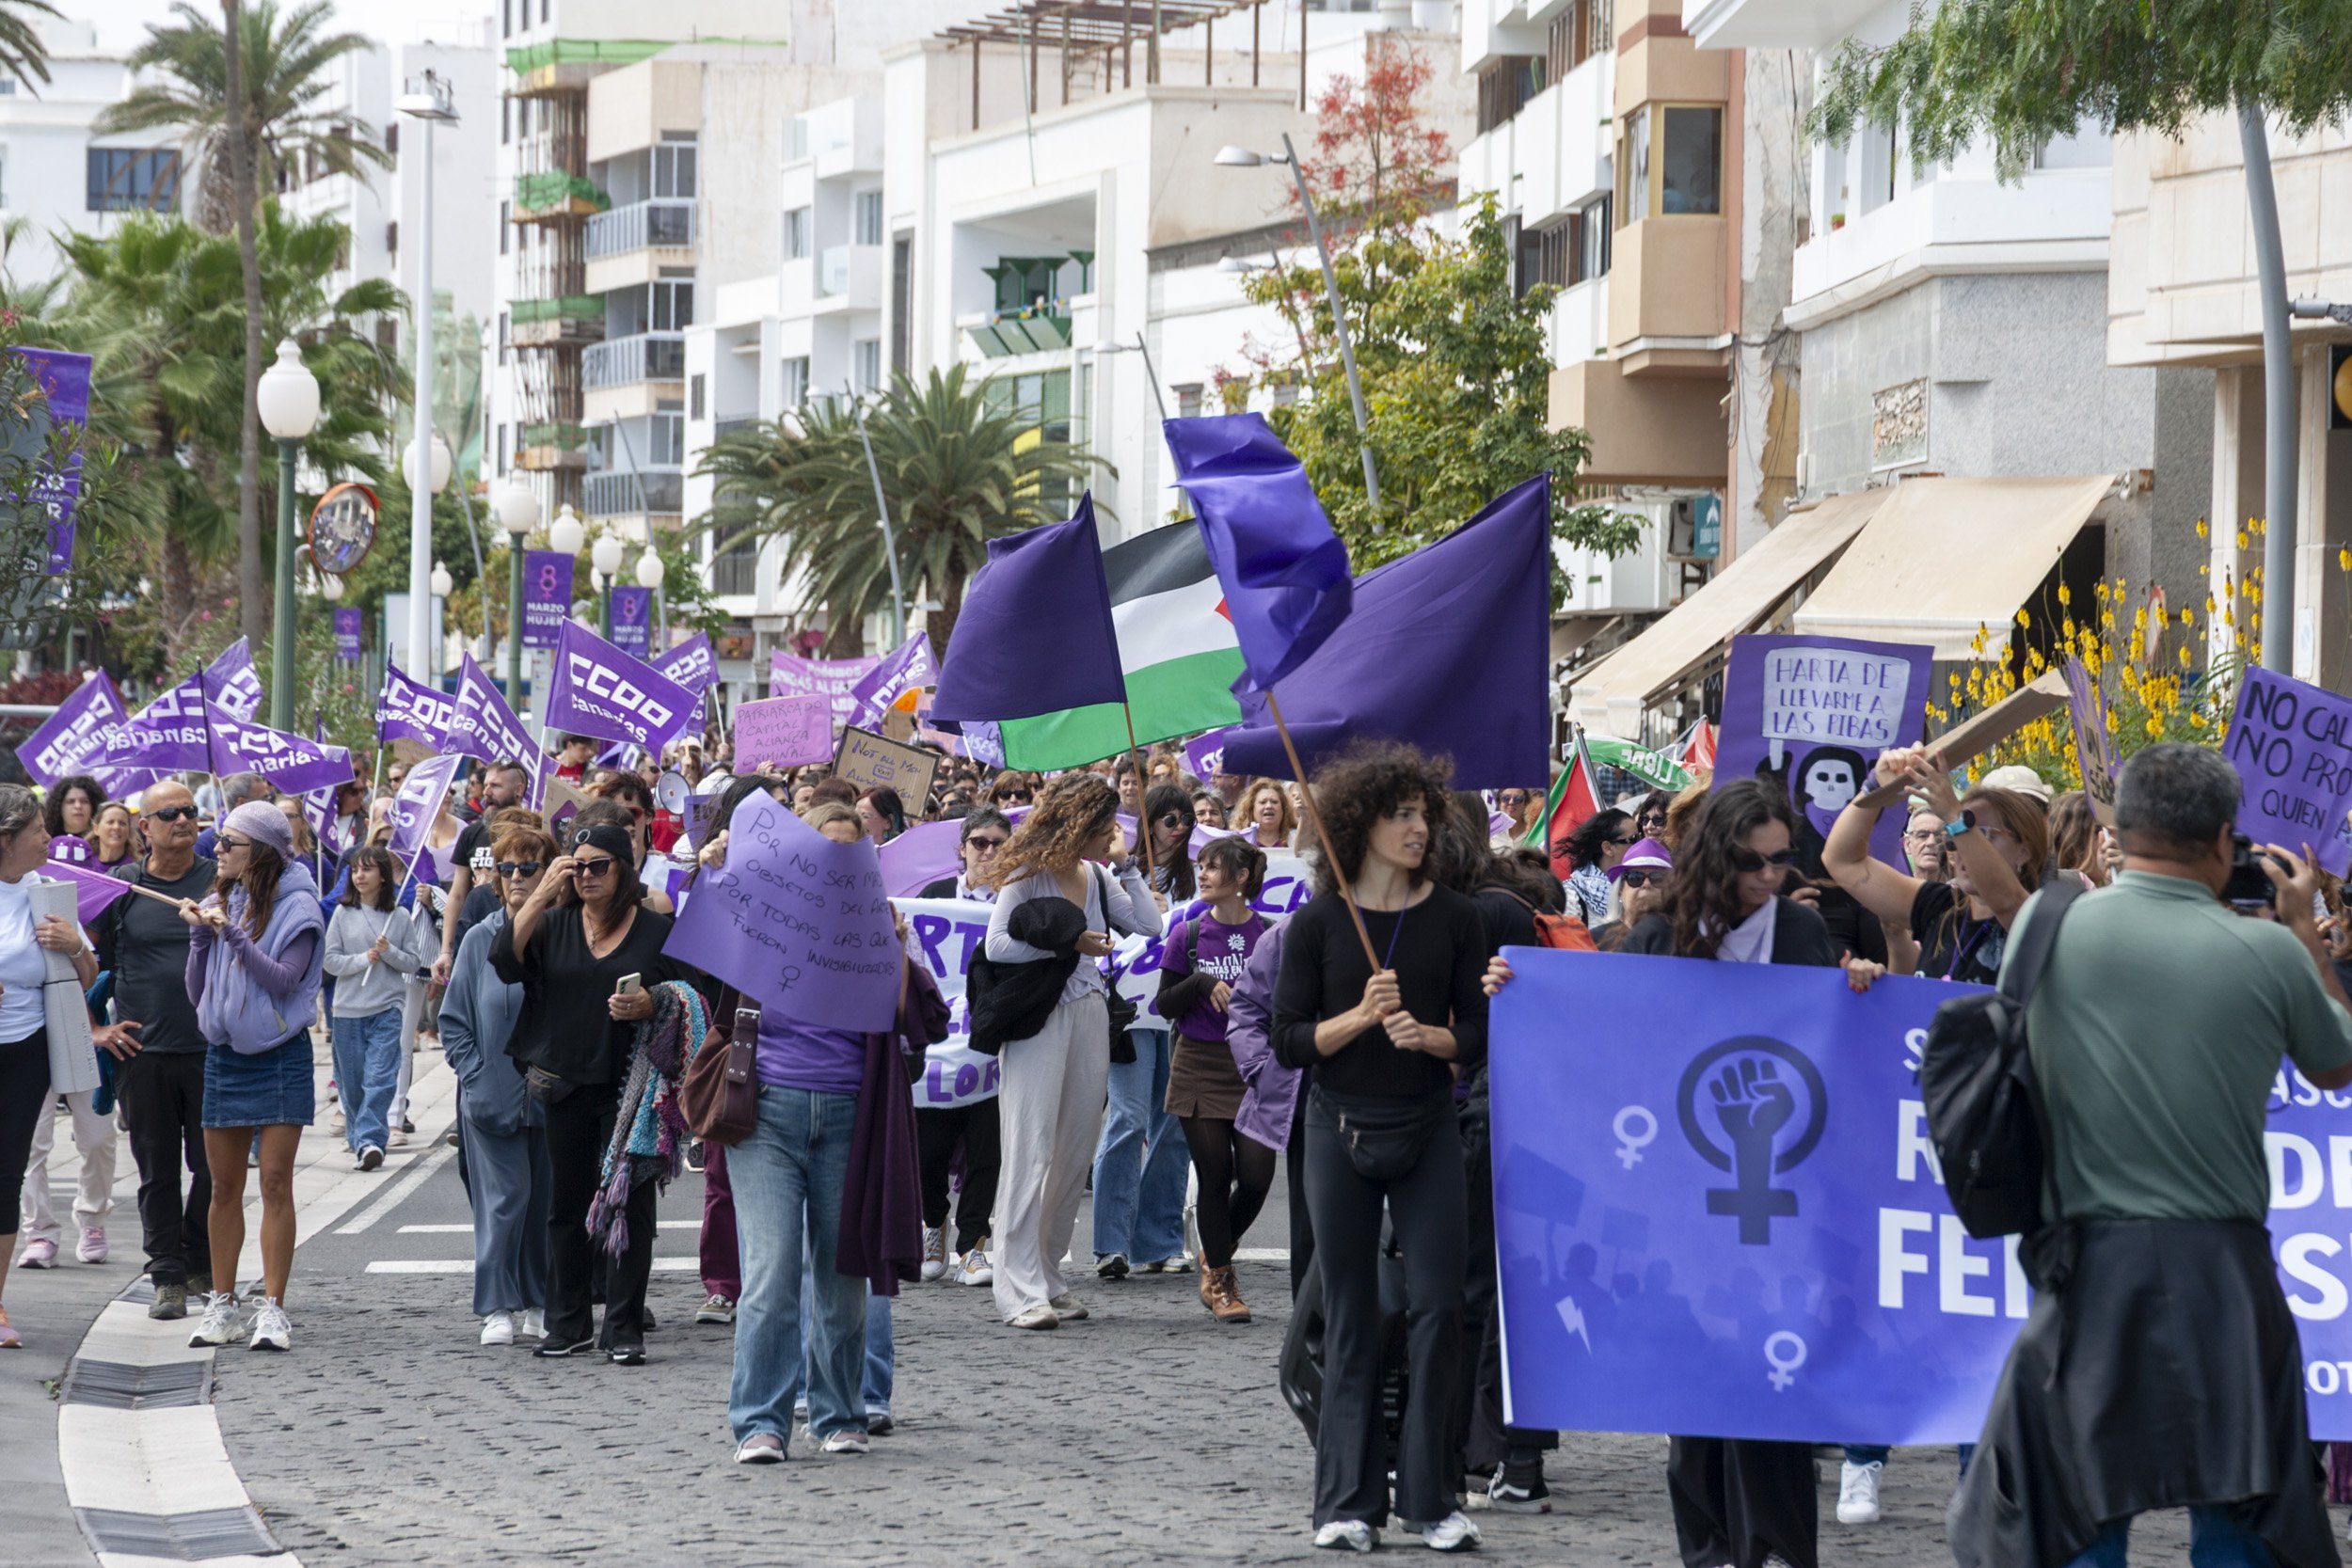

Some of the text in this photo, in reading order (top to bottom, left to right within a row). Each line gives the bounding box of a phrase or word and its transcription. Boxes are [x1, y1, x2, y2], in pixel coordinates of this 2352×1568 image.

[527, 602, 565, 613] MARZO
[614, 625, 645, 634] MARZO
[614, 634, 644, 644] MUJER
[1775, 657, 1892, 689] HARTA DE
[569, 652, 674, 729] CCOO
[1868, 694, 1885, 715] A
[2243, 680, 2298, 732] NO
[737, 700, 823, 725] PATRIARCADO
[745, 719, 800, 736] CAPITAL
[1772, 711, 1890, 741] LAS PIBAS
[754, 729, 809, 749] ALIANZA
[2233, 724, 2294, 778] NO
[742, 744, 812, 767] CRIMINAL
[2261, 788, 2328, 832] QUIEN
[748, 807, 782, 858] POR
[788, 852, 818, 878] NO
[822, 868, 855, 891] SER
[745, 858, 826, 909] OBJETOS
[839, 900, 864, 916] DEL
[718, 872, 751, 909] POR
[760, 901, 821, 942] TODAS
[833, 932, 863, 949] LAS
[730, 910, 787, 956] FUERON
[903, 912, 989, 978] RT
